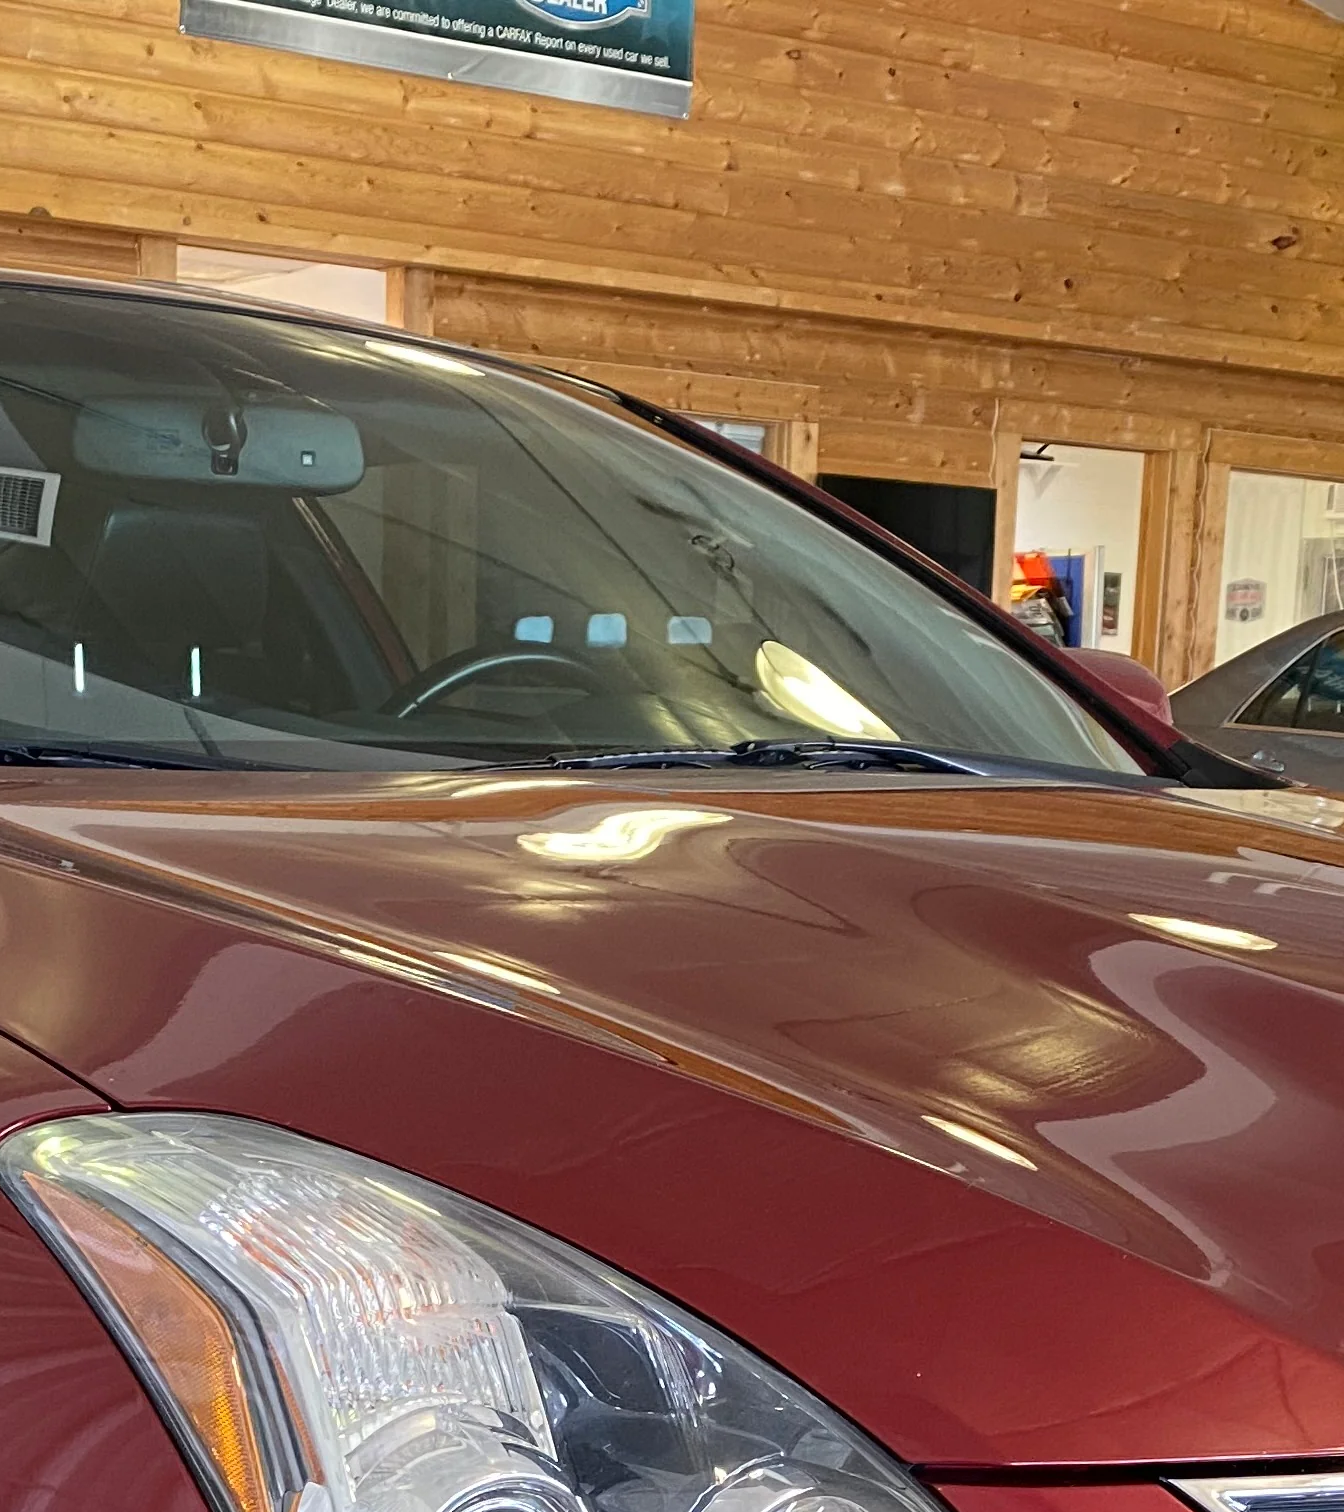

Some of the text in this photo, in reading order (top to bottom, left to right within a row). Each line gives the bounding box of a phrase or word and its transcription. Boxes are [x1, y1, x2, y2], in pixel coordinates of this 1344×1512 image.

[533, 0, 607, 14] LER
[360, 3, 374, 15] we
[376, 5, 391, 18] are
[392, 8, 439, 27] committed
[441, 16, 450, 29] to
[452, 19, 486, 38] offering
[487, 26, 494, 37] a
[534, 32, 563, 50] Report
[565, 40, 577, 51] on
[578, 42, 601, 58] every
[603, 47, 624, 60] used
[624, 50, 639, 63] car
[640, 53, 653, 65] we
